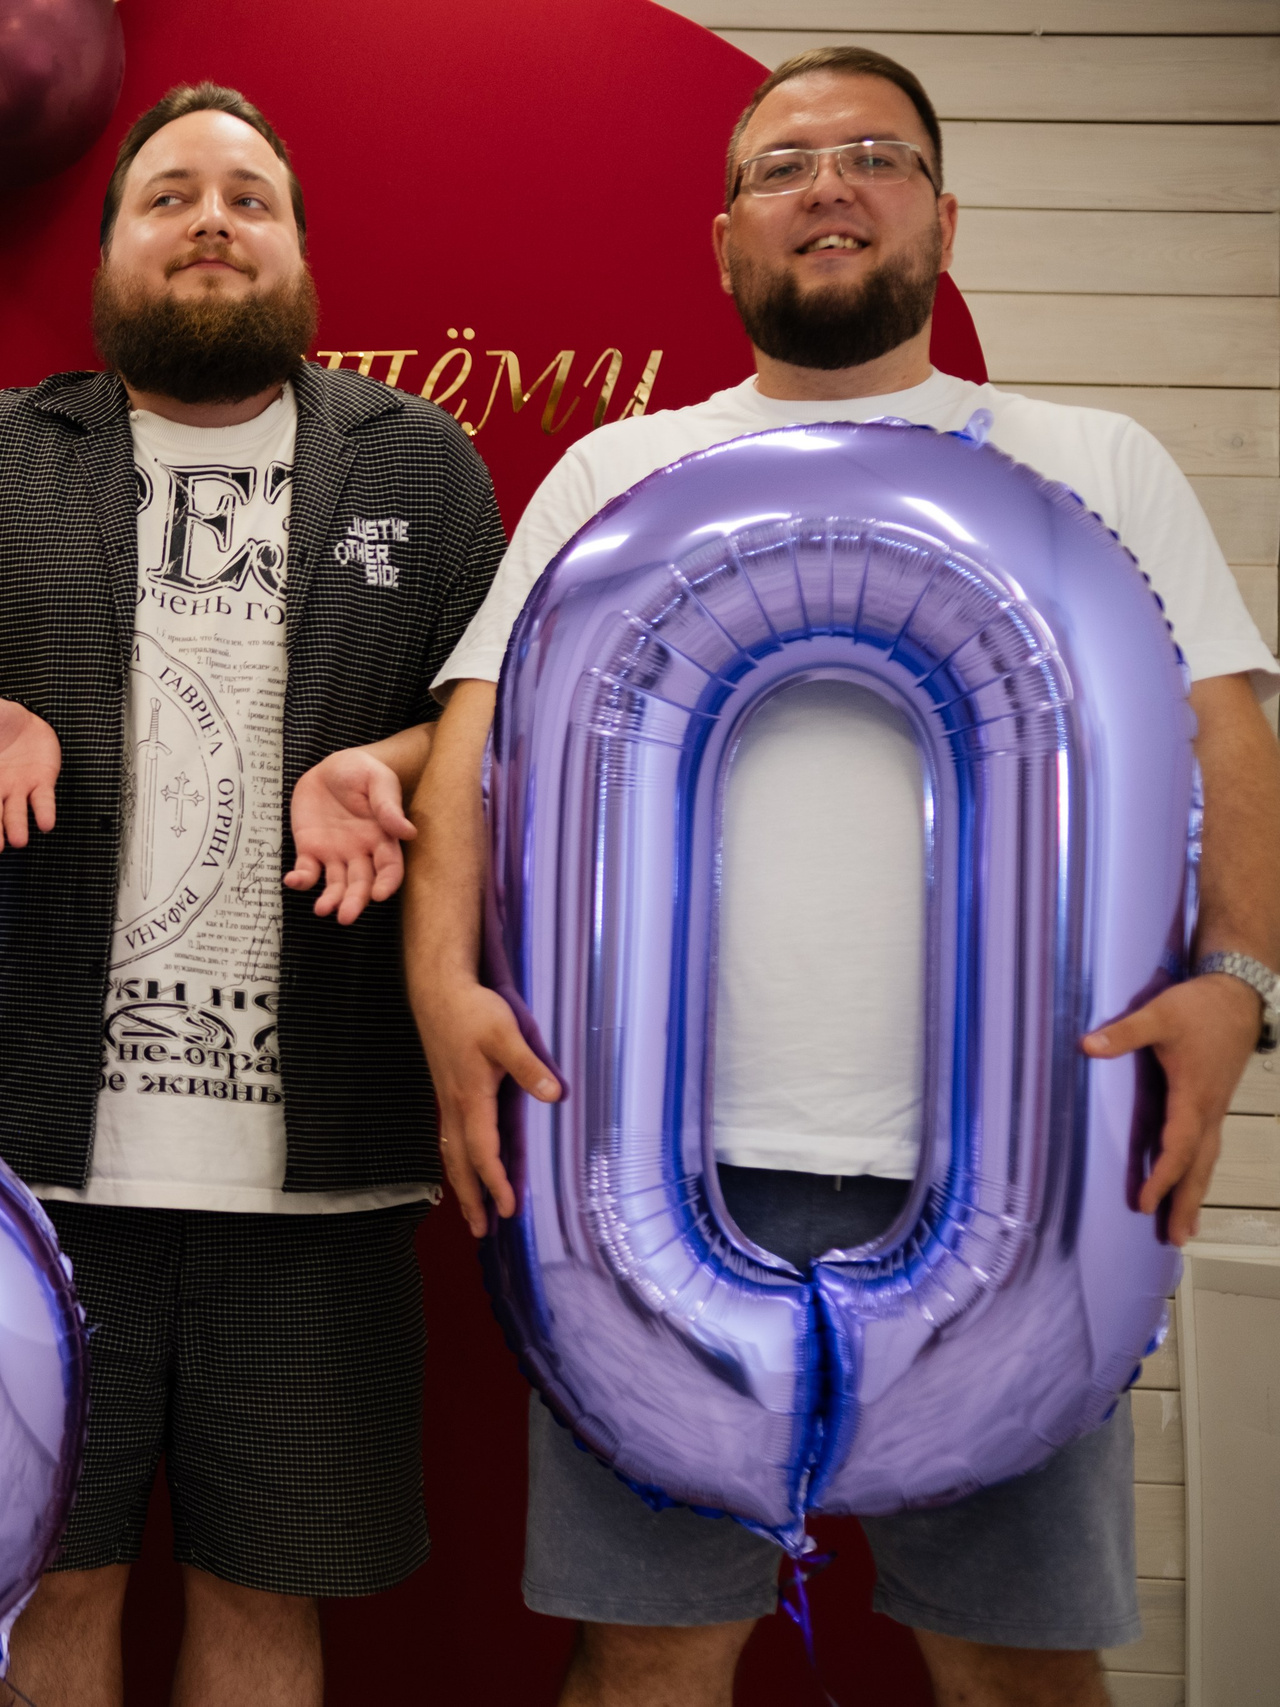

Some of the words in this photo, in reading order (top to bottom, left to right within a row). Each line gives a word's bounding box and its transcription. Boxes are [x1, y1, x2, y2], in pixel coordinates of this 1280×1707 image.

[334, 538, 389, 565] OTHER
[365, 564, 400, 588] SIDE
[139, 1074, 282, 1103] жизнь
